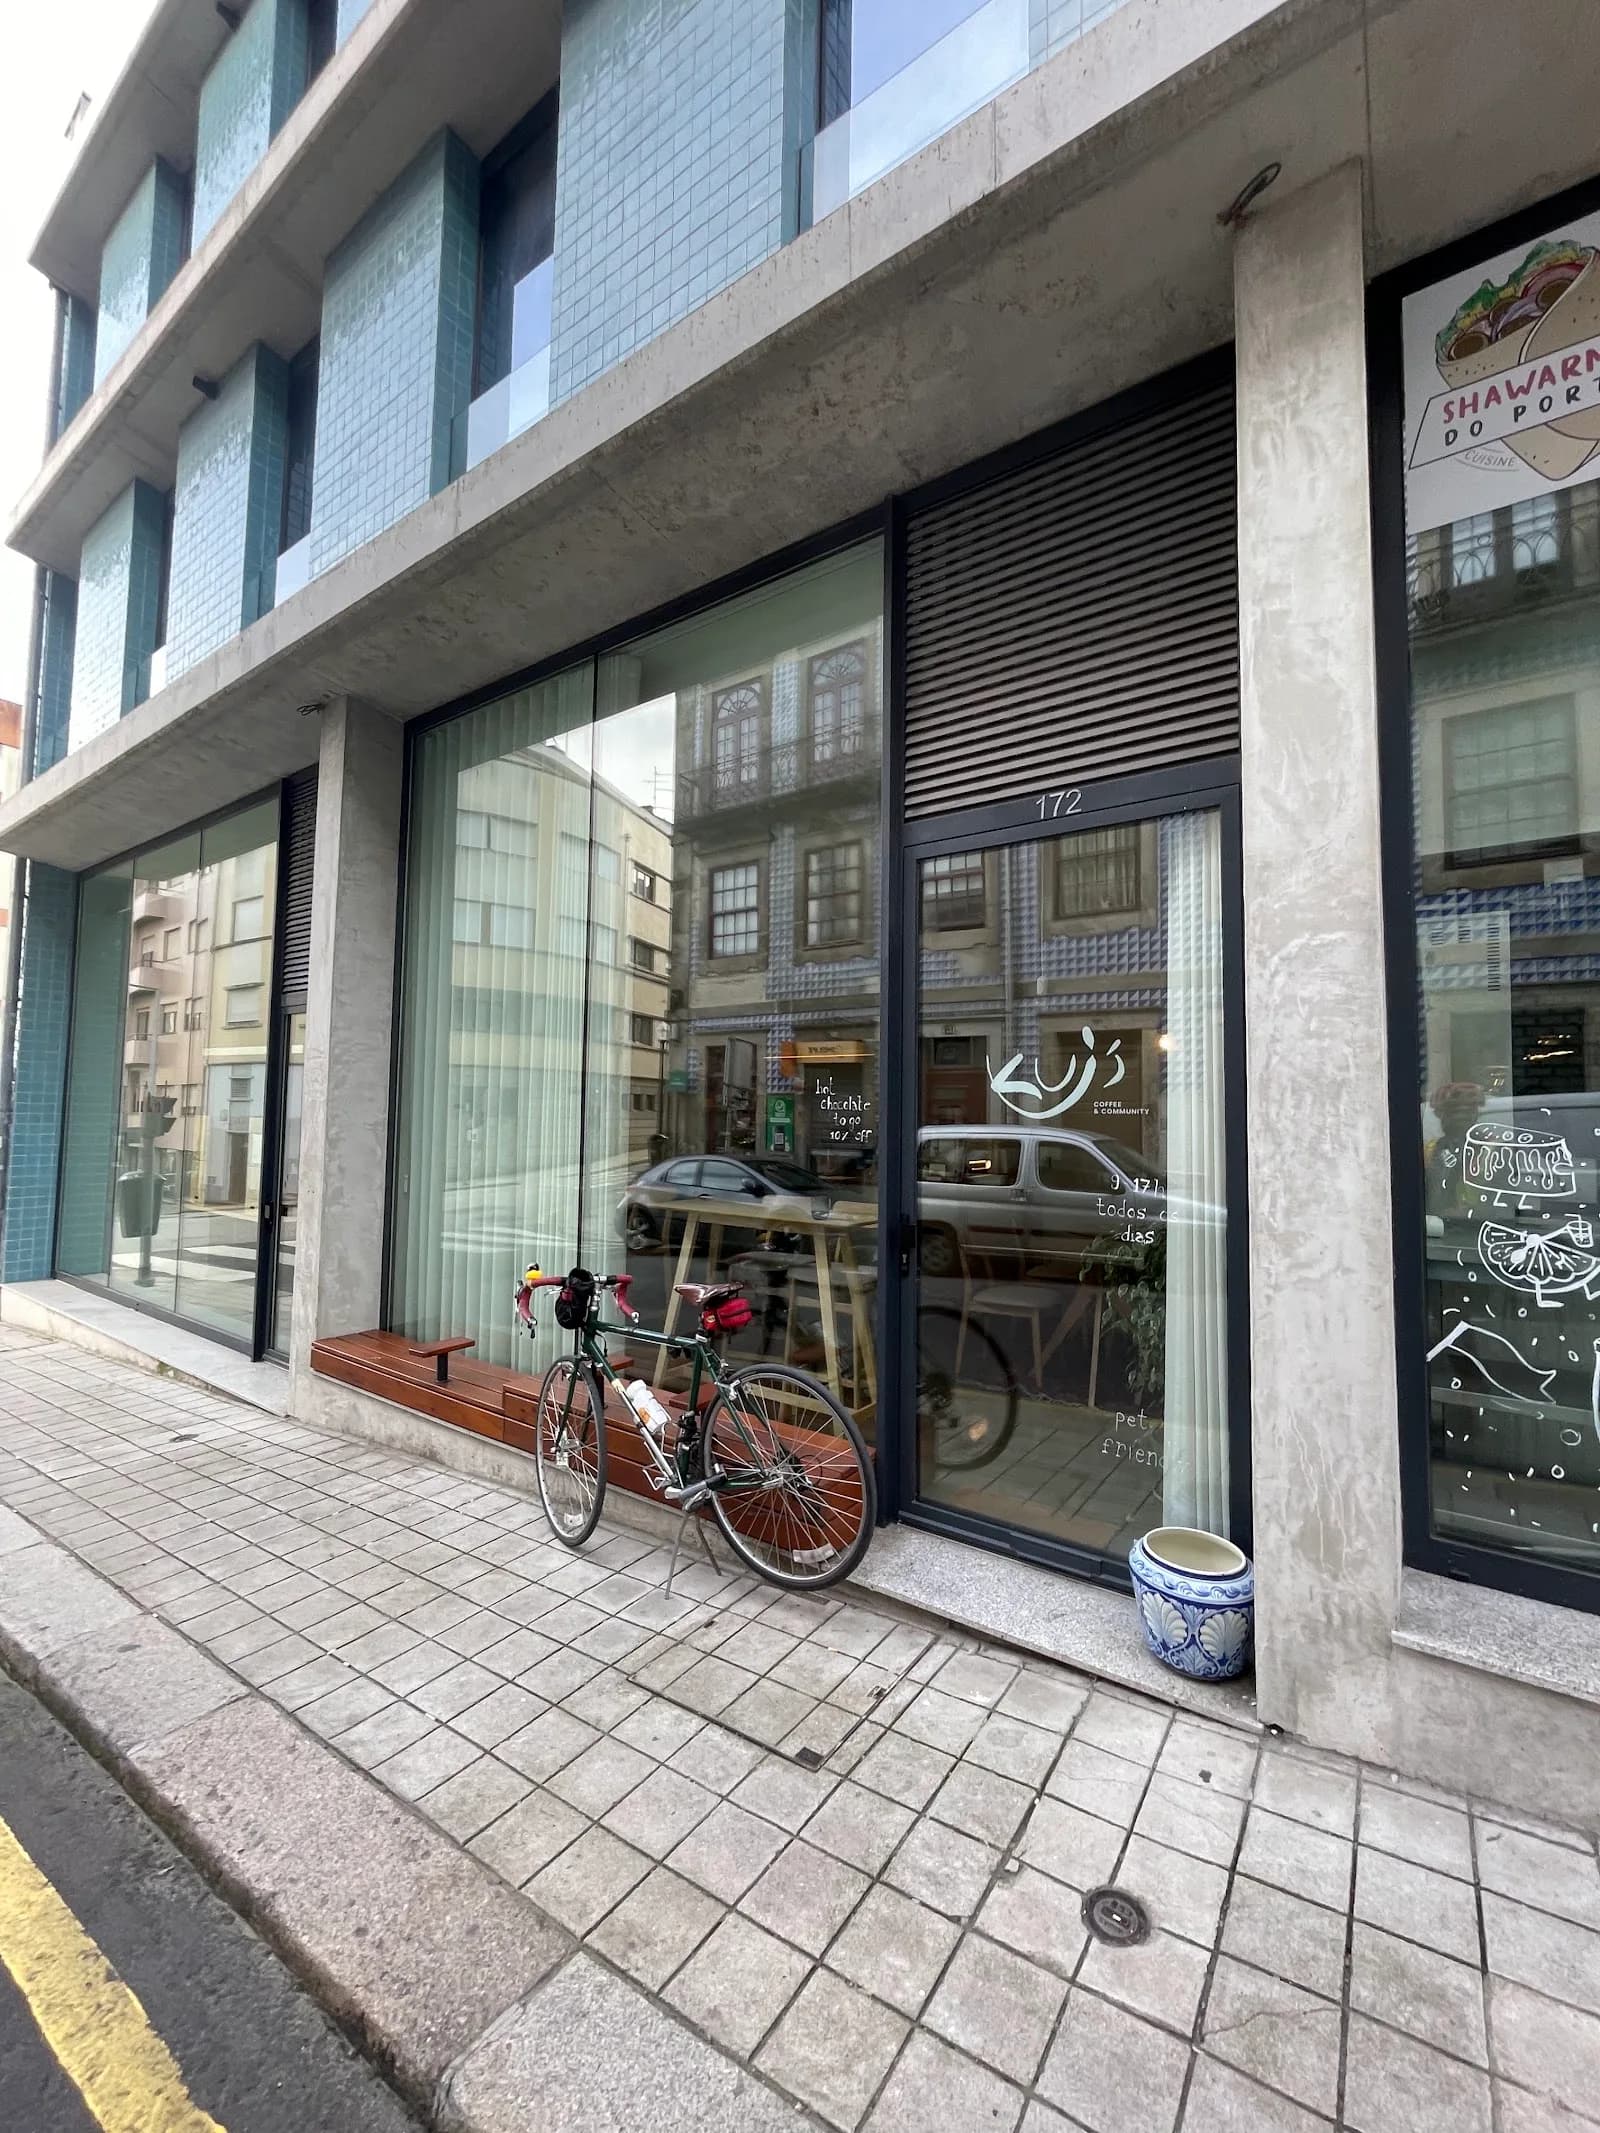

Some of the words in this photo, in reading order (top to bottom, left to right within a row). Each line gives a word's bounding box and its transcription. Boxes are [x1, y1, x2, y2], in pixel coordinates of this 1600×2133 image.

[1444, 420, 1483, 446] DO
[1464, 449, 1516, 467] CUISINE
[1035, 788, 1082, 820] 172
[815, 1076, 836, 1096] hot
[820, 1094, 871, 1112] chocolate
[833, 1112, 847, 1126] to
[848, 1116, 861, 1132] go
[829, 1130, 849, 1141] 10%
[854, 1129, 873, 1143] off
[1096, 1197, 1147, 1220] todos
[1115, 1408, 1148, 1432] pet
